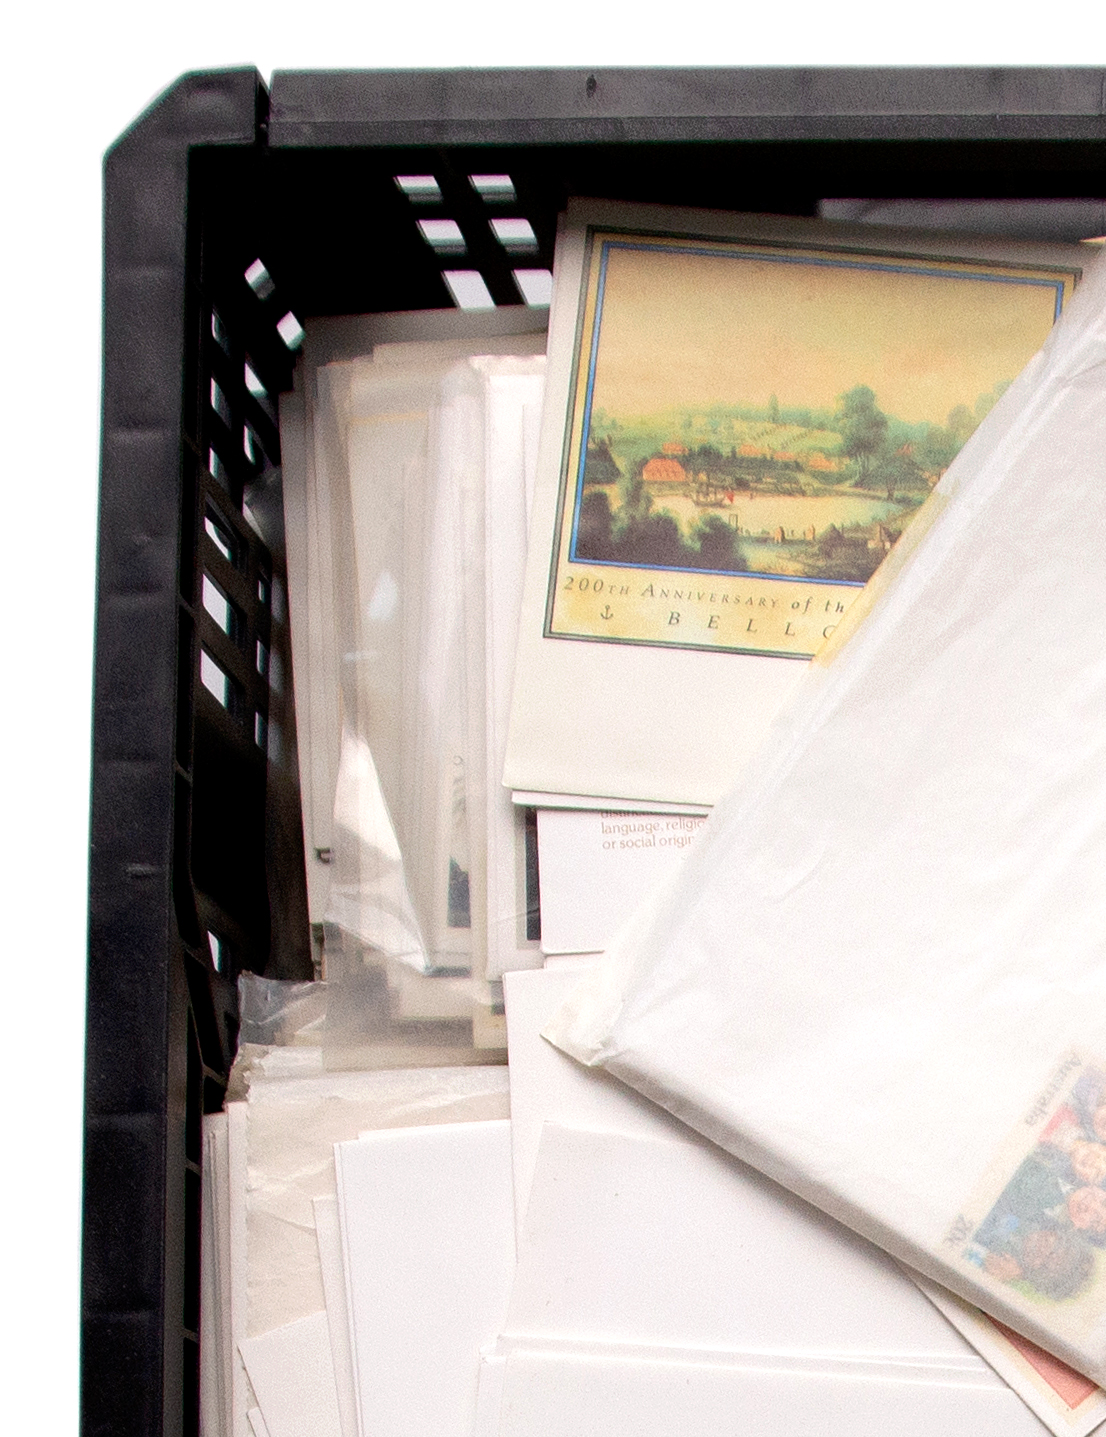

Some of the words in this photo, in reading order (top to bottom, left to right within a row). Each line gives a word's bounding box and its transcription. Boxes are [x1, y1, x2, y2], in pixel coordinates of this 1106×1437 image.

[791, 596, 812, 614] of
[601, 822, 664, 836] language,
[602, 840, 616, 850] or
[619, 834, 656, 850] social
